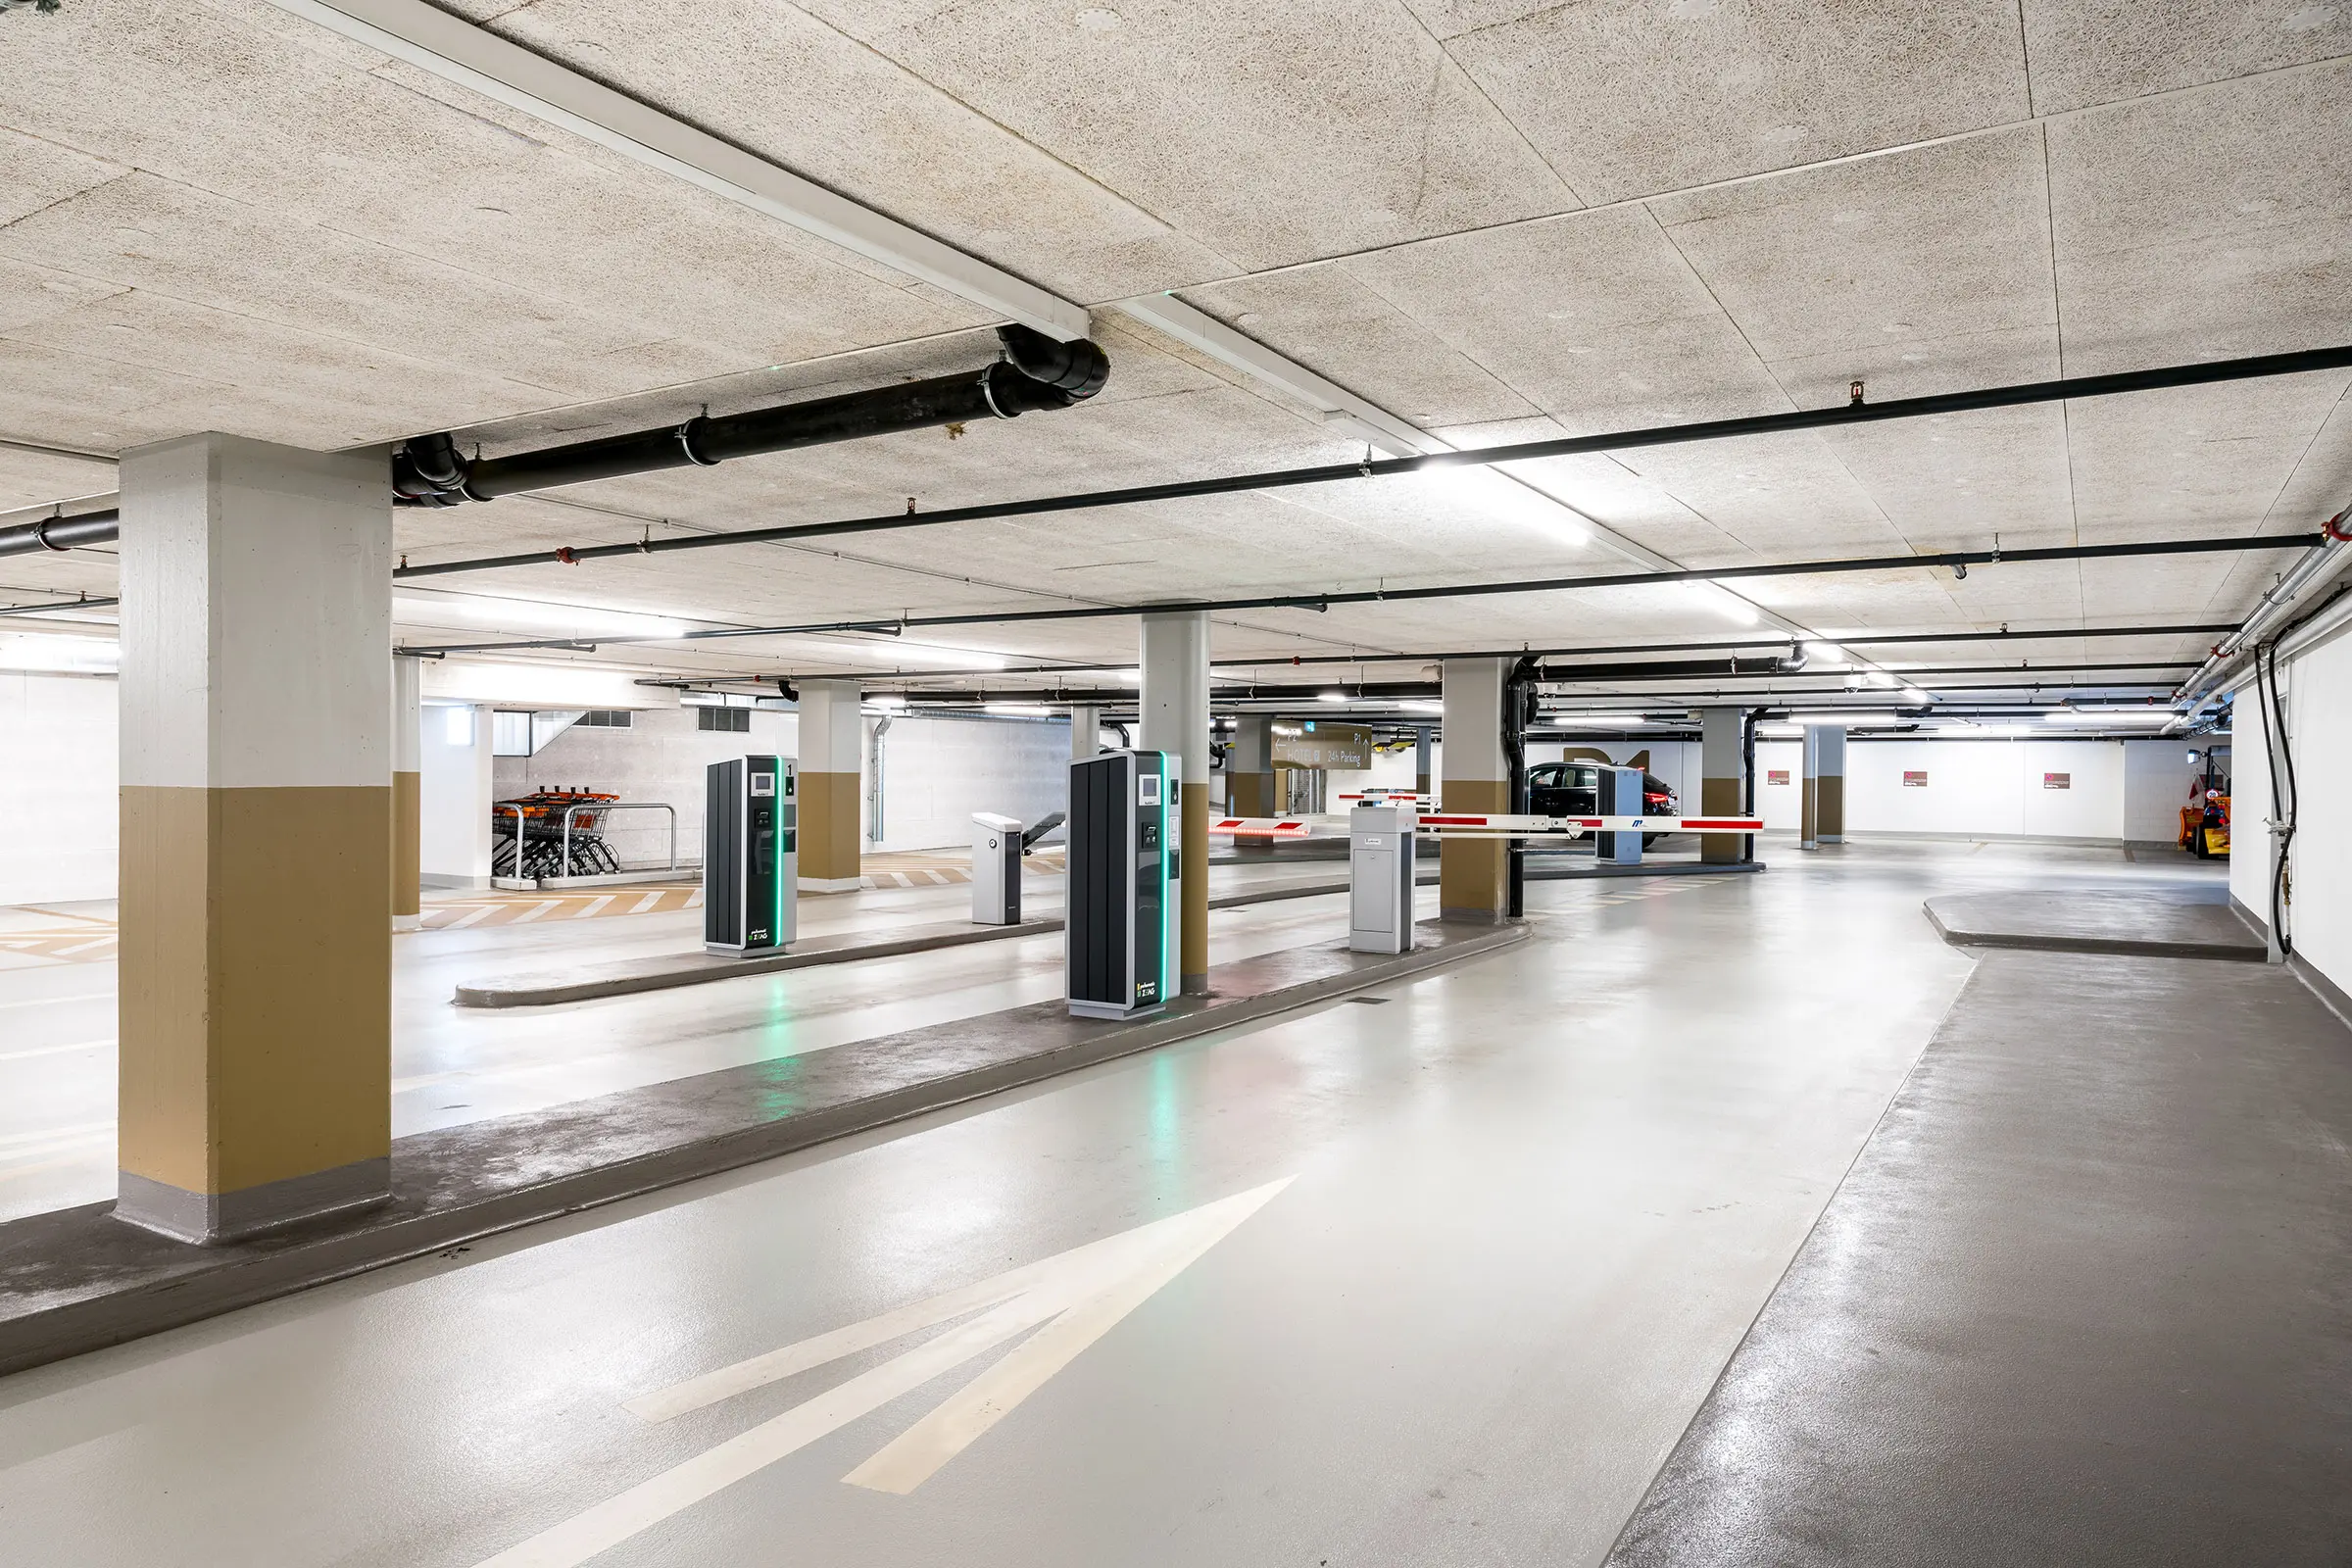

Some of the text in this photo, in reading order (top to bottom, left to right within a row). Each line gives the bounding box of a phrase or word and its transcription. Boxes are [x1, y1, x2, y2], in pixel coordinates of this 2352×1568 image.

[1353, 733, 1361, 745] P1
[1287, 749, 1312, 761] HOTEL
[1327, 751, 1340, 762] 24h
[1341, 751, 1361, 767] Parking
[787, 763, 792, 775] 1
